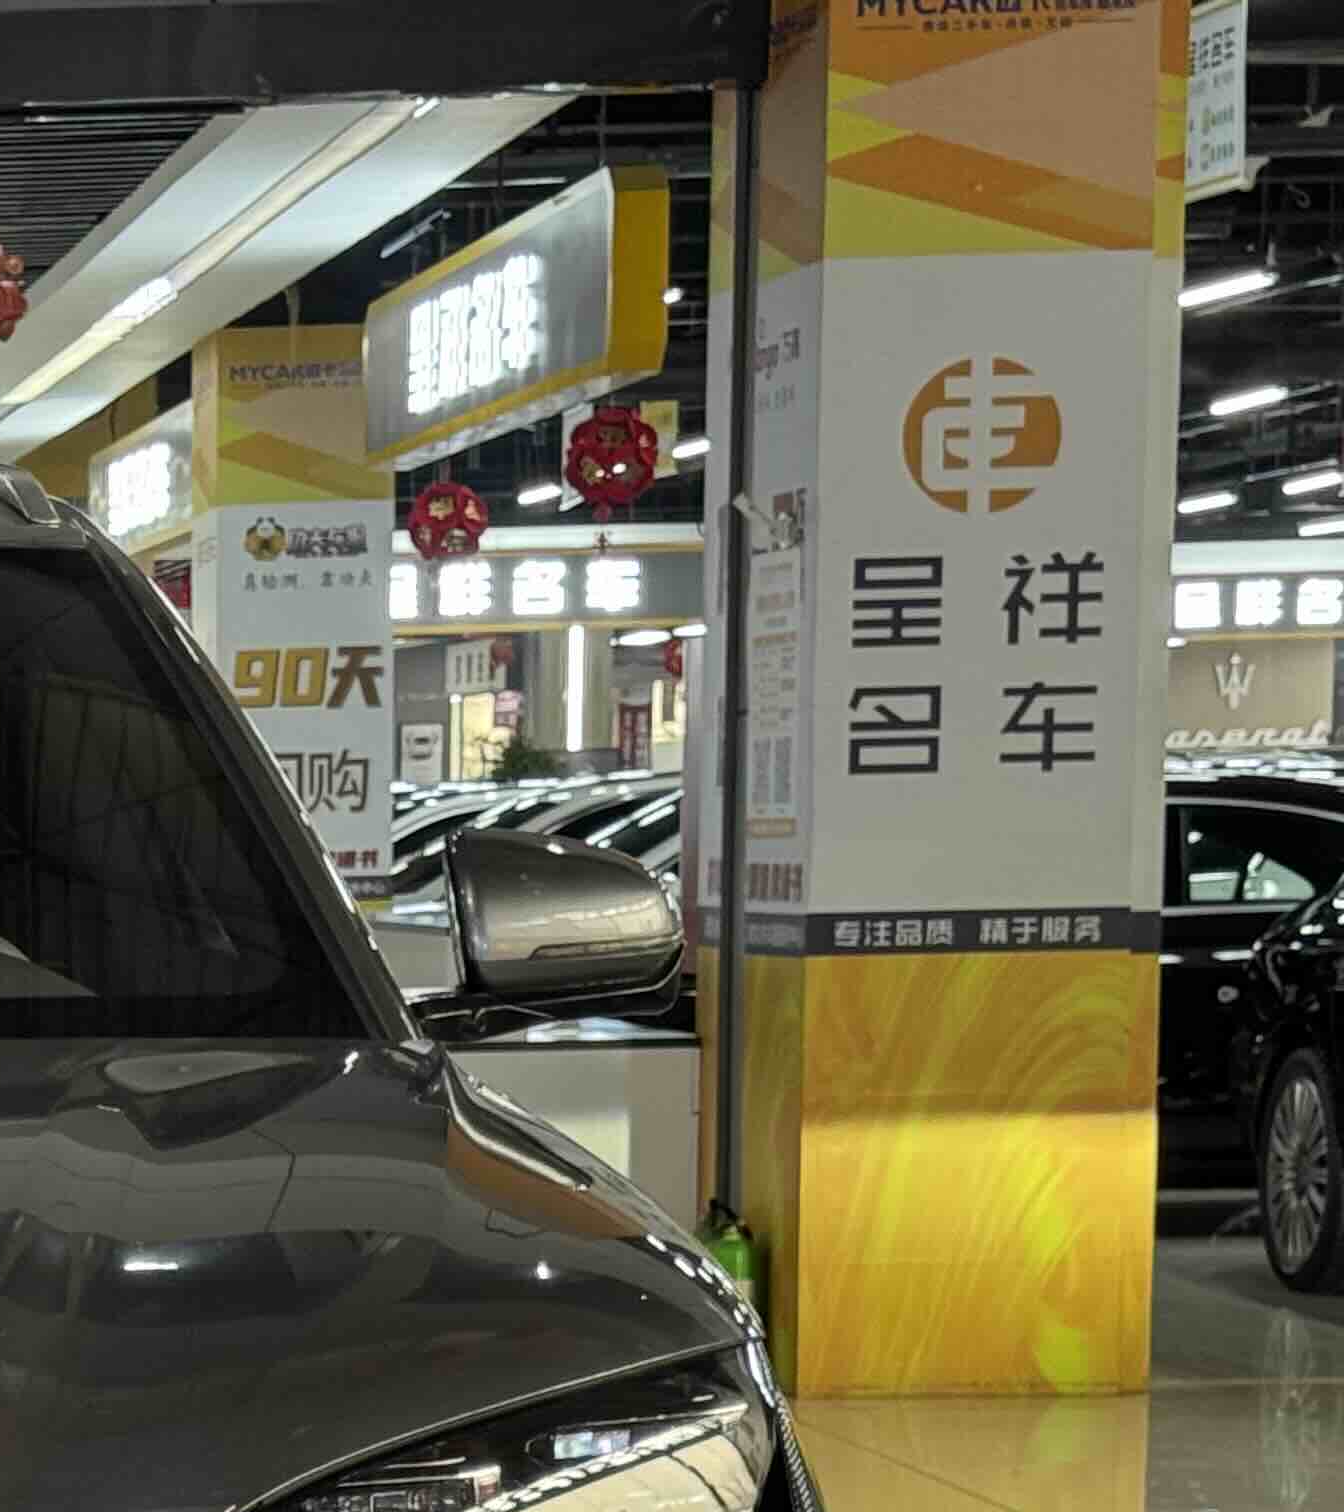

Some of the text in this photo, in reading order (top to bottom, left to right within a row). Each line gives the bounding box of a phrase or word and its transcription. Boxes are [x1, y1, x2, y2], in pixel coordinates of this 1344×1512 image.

[851, 551, 1105, 649] 呈祥
[234, 646, 384, 709] 90天
[847, 681, 1099, 776] 名车
[833, 918, 955, 948] 专注品质
[978, 914, 1103, 946] 精于服务
